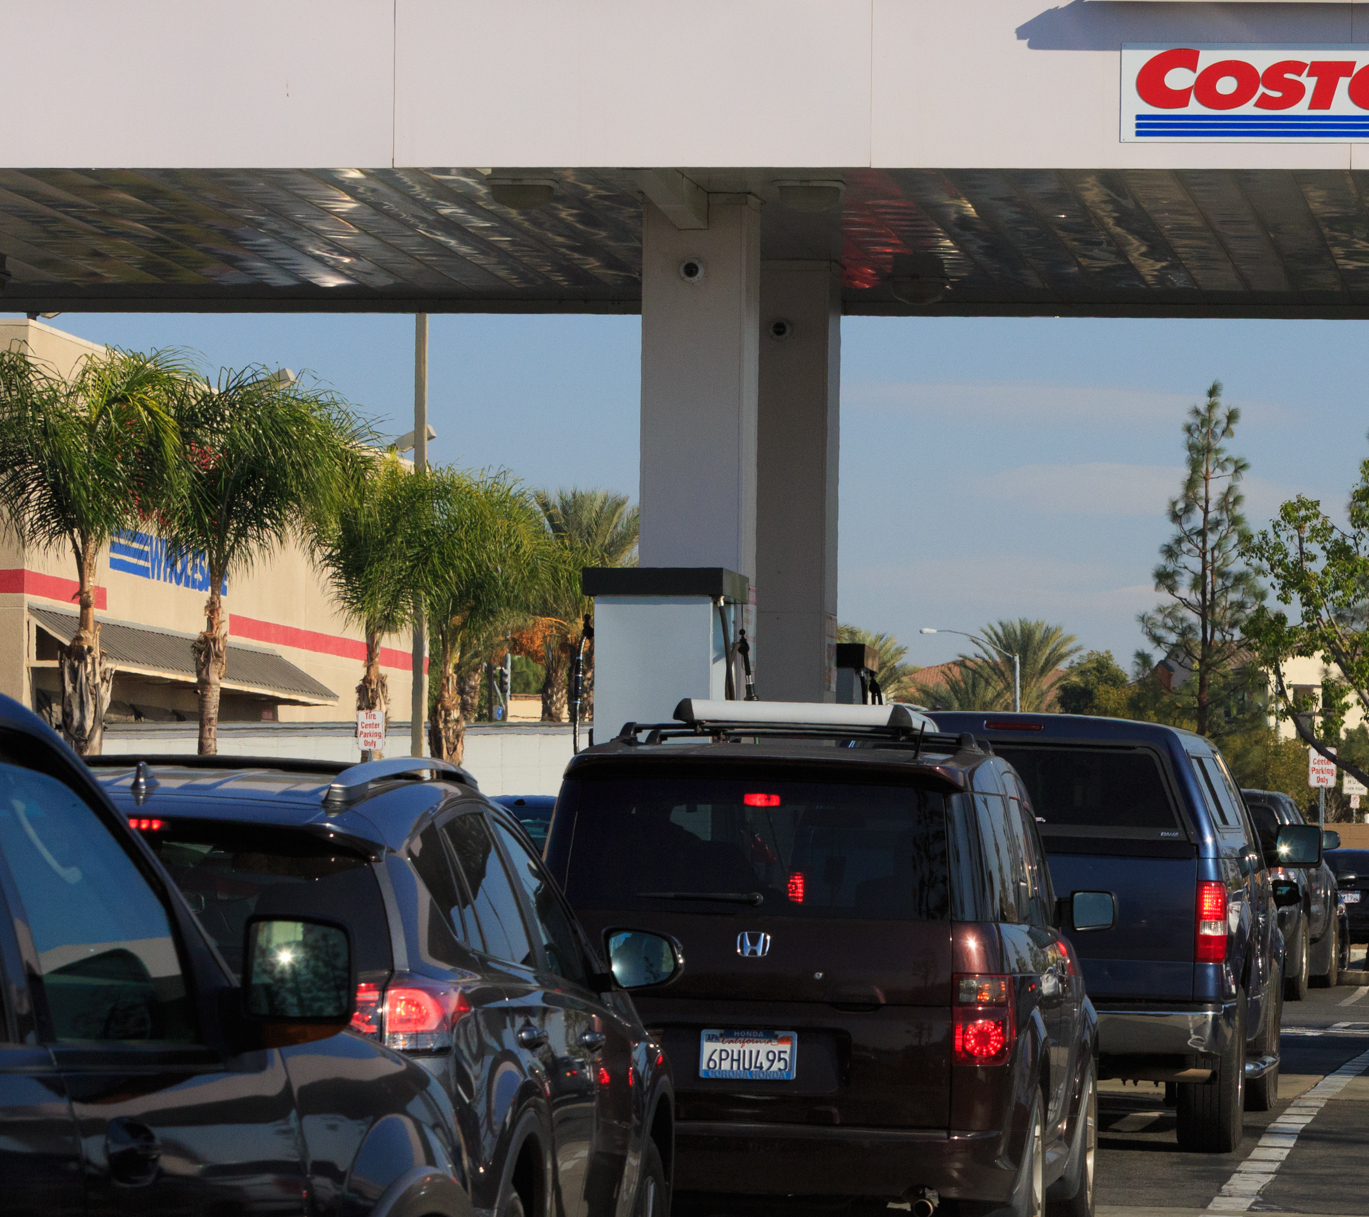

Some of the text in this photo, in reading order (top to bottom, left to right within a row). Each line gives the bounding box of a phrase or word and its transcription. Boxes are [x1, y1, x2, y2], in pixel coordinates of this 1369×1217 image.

[365, 712, 376, 720] Tire
[361, 721, 380, 729] Center
[359, 730, 382, 739] Parking
[364, 740, 377, 748] Only
[1311, 767, 1334, 776] Parking
[1316, 776, 1329, 784] Only
[733, 1030, 765, 1038] HONDA
[721, 1038, 773, 1048] California
[706, 1048, 789, 1072] 6PHU495
[708, 1069, 787, 1080] CORONA HONDA
